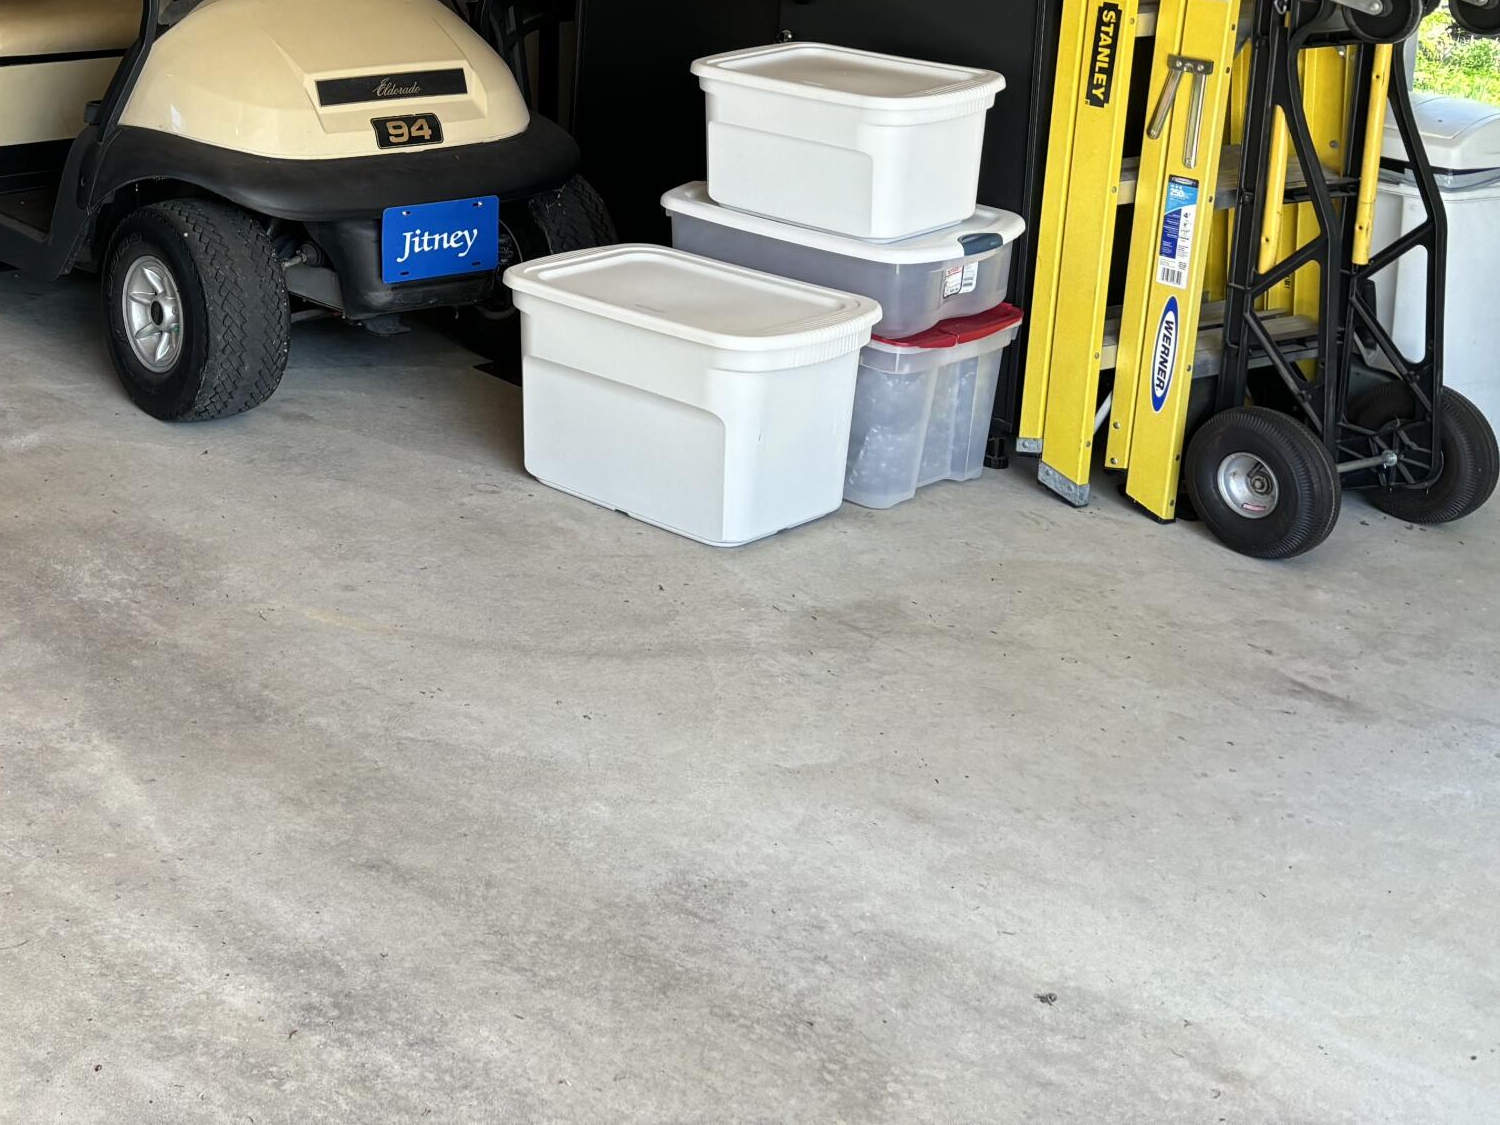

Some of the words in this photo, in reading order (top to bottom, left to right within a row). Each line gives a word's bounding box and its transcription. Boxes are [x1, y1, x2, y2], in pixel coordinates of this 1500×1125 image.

[1092, 9, 1116, 101] STANLEY
[372, 77, 421, 97] Eldorado
[386, 118, 433, 144] 94
[396, 228, 478, 263] Jitney
[1155, 319, 1174, 391] WERNER
